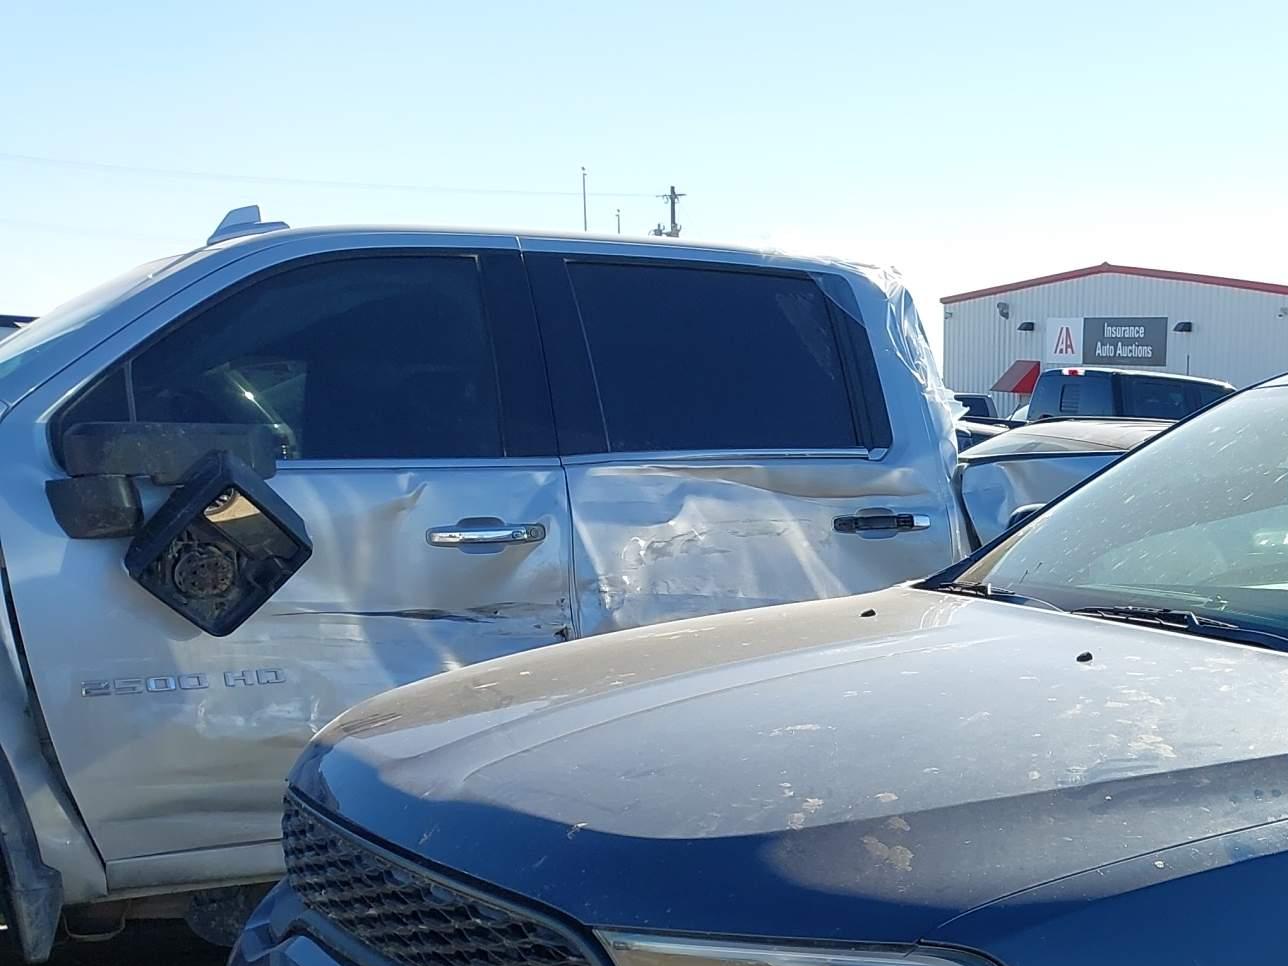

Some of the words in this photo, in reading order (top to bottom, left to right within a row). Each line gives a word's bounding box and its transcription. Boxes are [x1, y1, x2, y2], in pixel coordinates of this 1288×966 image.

[1104, 322, 1145, 337] Insurance
[1096, 342, 1114, 357] Auto
[1116, 342, 1152, 358] Auctions
[80, 675, 209, 697] 2500
[223, 668, 287, 687] HD
